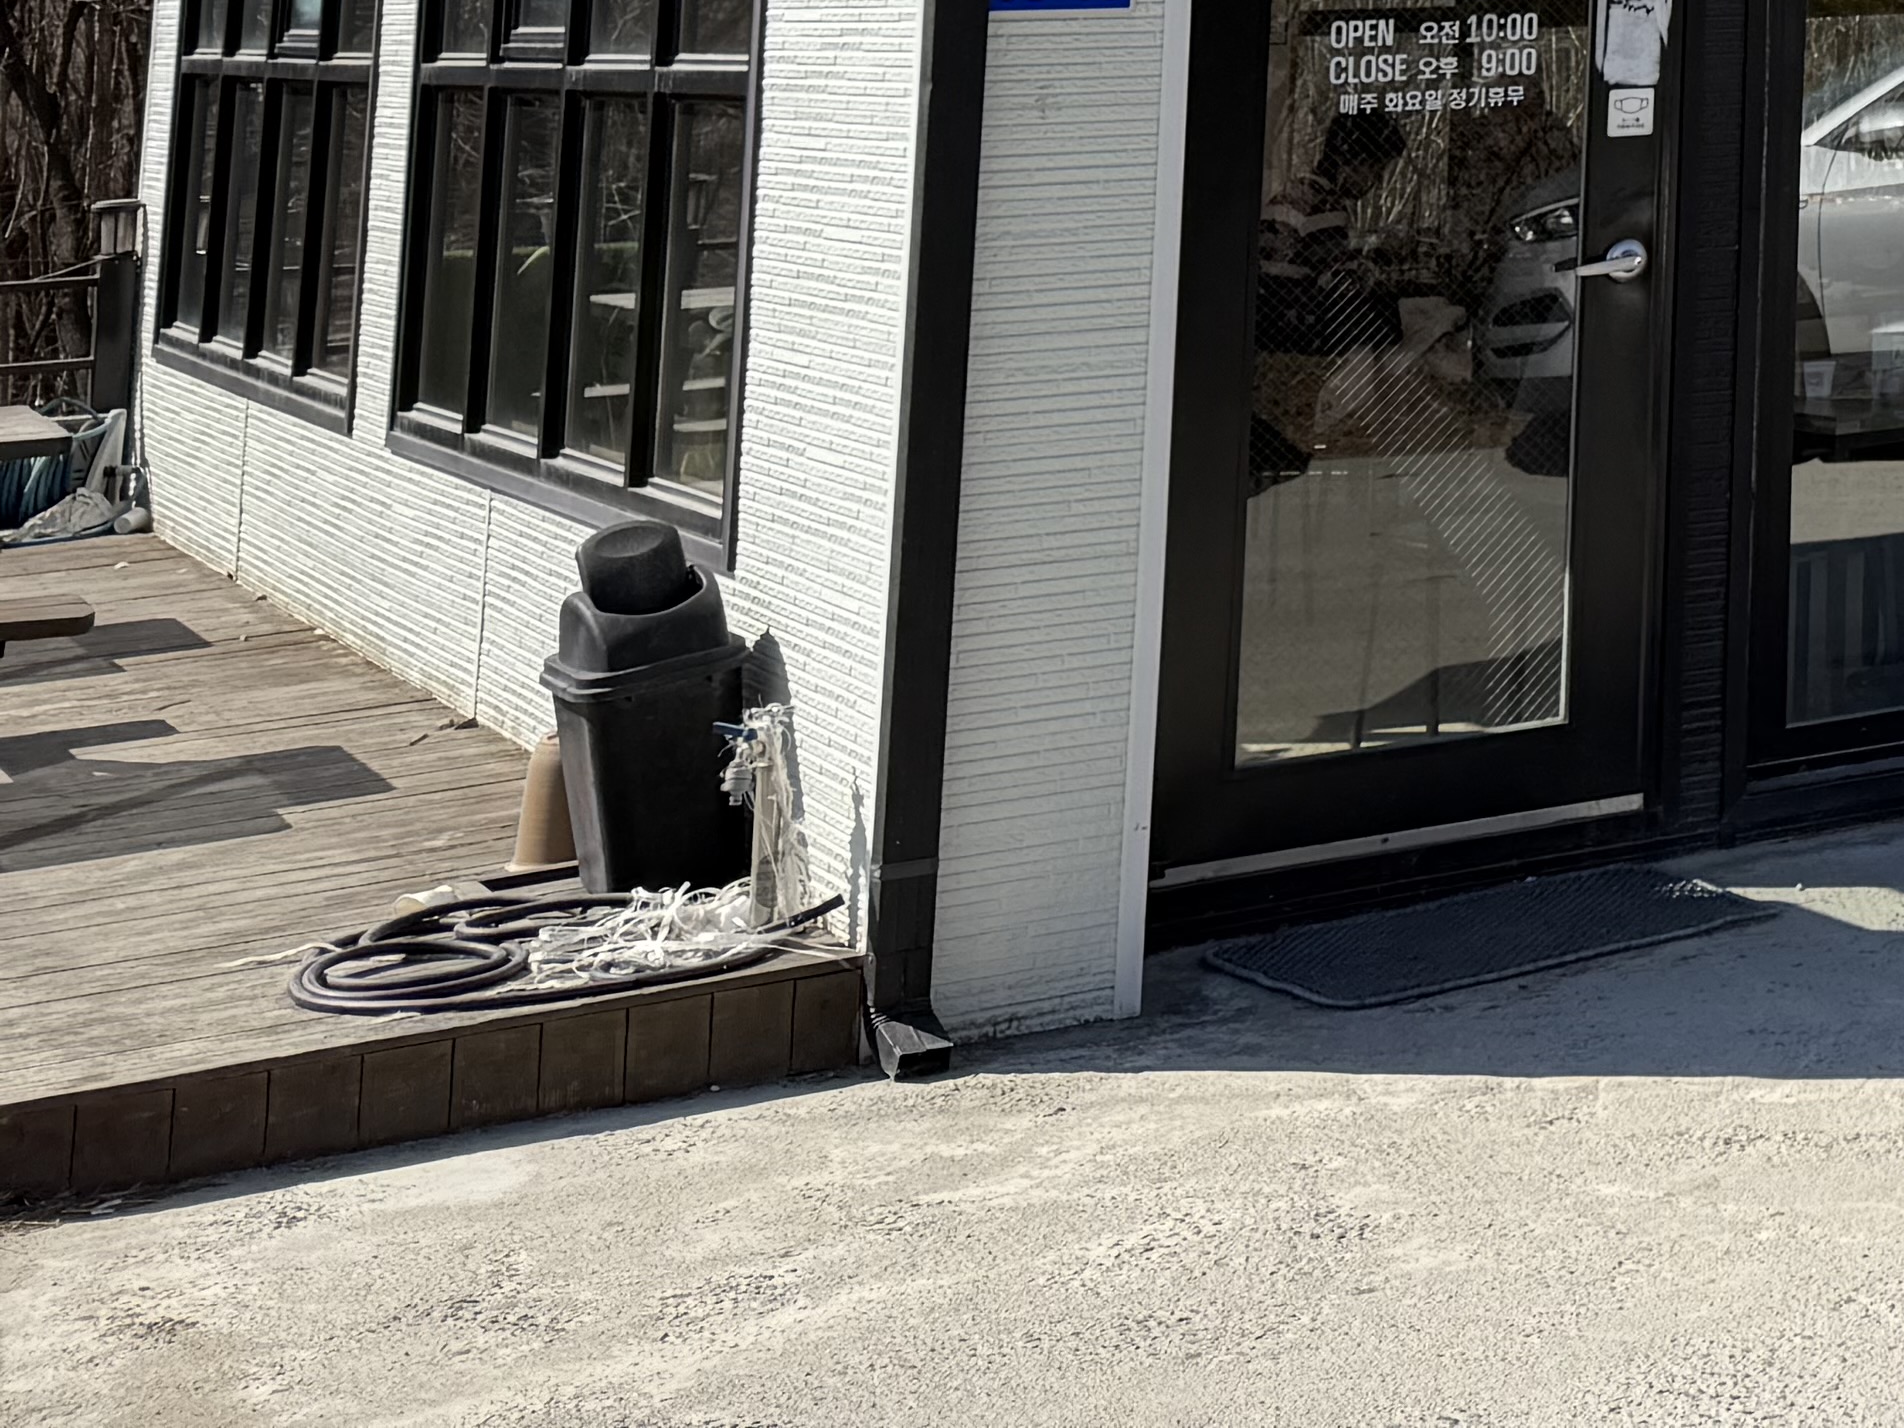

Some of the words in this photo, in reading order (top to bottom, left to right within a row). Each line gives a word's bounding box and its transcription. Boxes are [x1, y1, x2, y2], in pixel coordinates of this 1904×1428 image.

[1329, 18, 1396, 49] OPEN
[1418, 20, 1461, 45] 오전
[1465, 12, 1539, 43] 10:00
[1328, 53, 1409, 85] CLOSE
[1416, 56, 1460, 80] 오후
[1480, 47, 1538, 78] 9:00
[1339, 92, 1379, 116] 매주
[1384, 89, 1443, 113] 화요일
[1448, 85, 1526, 110] 정기휴무
